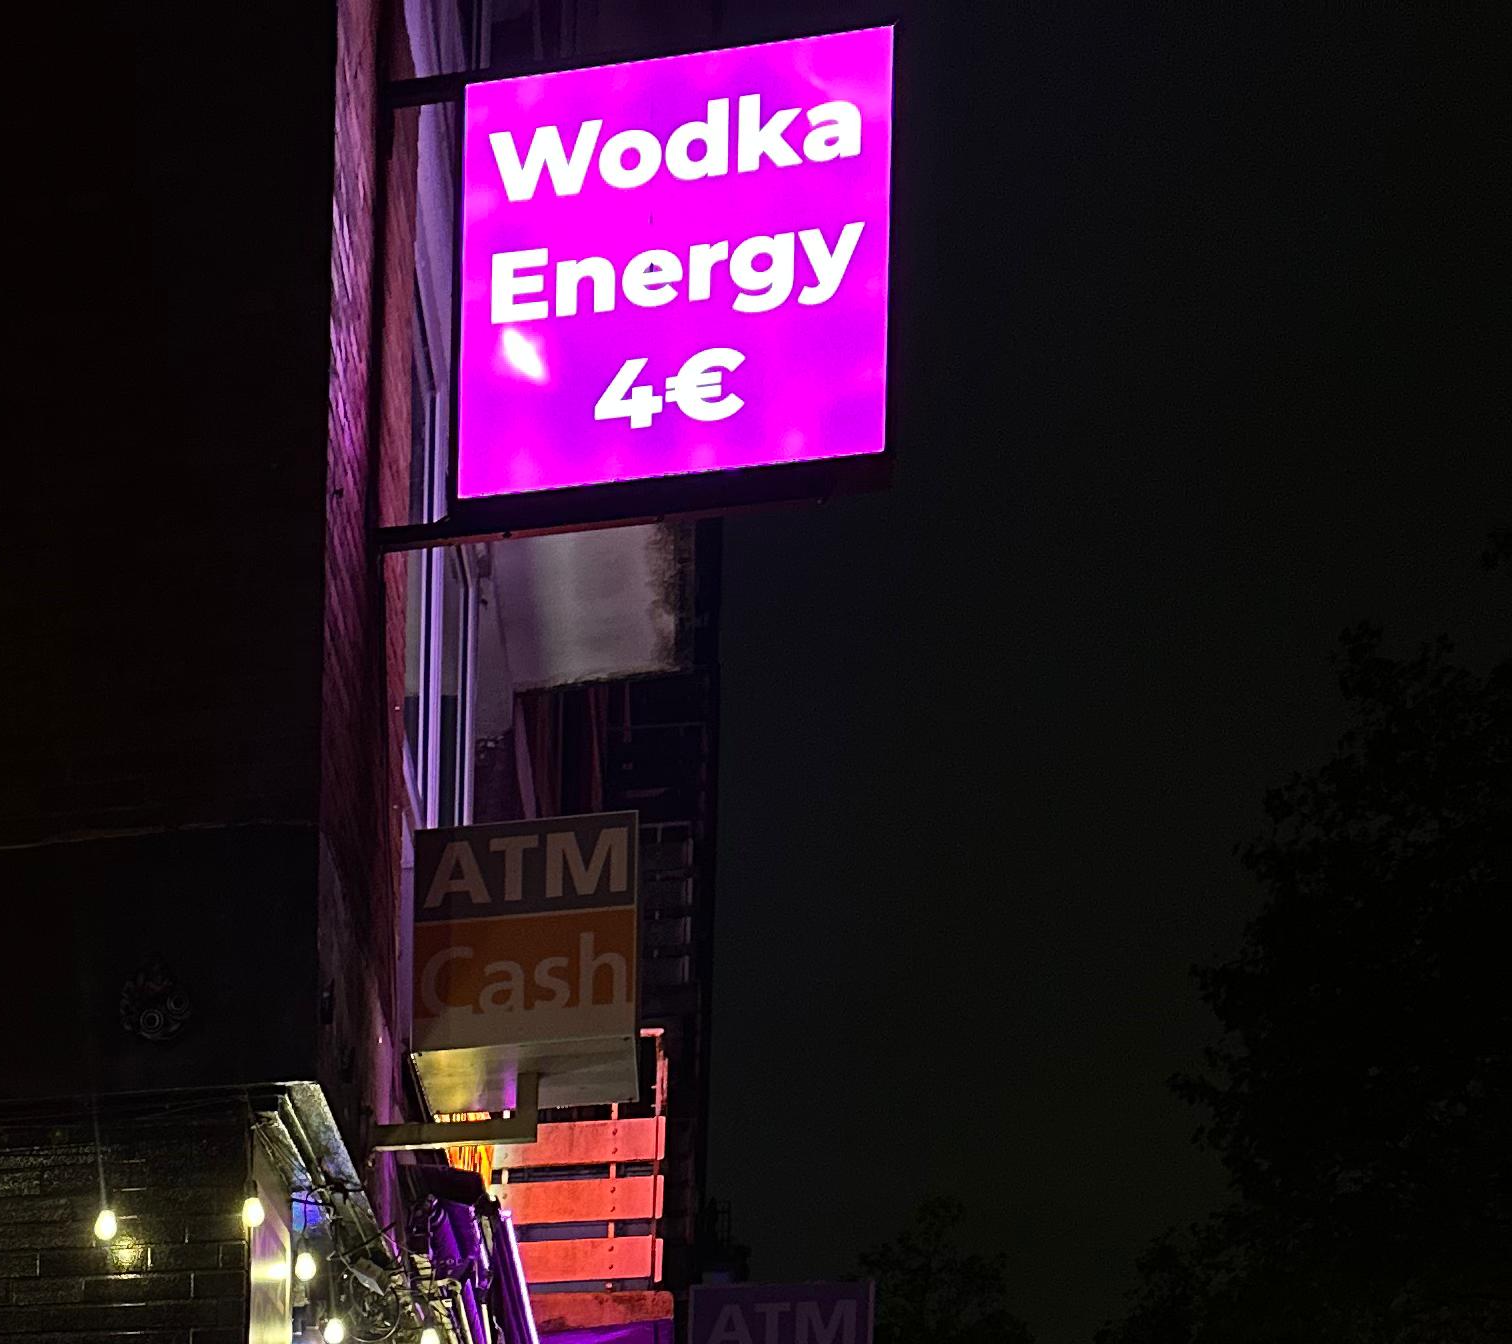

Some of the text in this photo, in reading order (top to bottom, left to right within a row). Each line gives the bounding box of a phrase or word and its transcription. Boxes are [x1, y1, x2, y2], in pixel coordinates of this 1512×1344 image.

[489, 93, 862, 203] Wodka
[490, 221, 866, 324] Energy
[593, 347, 746, 430] 4€
[425, 826, 630, 910] ATM
[421, 932, 627, 1017] Cash
